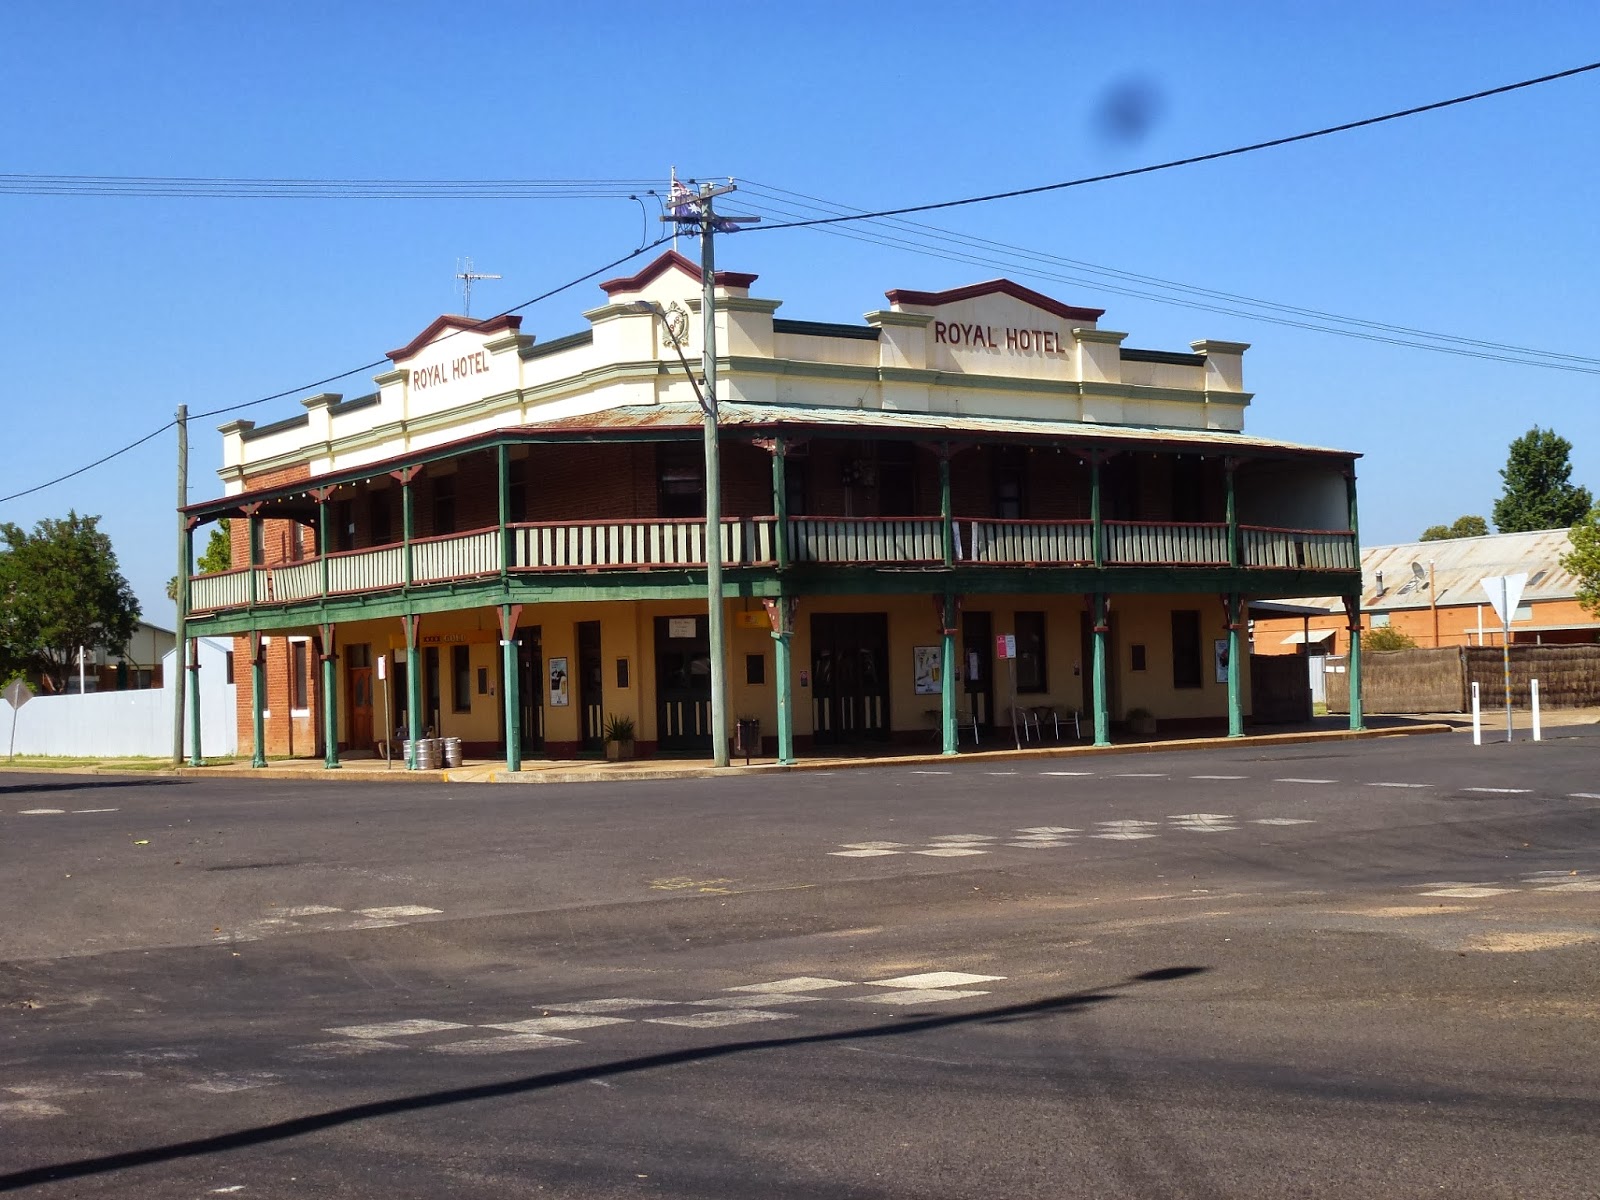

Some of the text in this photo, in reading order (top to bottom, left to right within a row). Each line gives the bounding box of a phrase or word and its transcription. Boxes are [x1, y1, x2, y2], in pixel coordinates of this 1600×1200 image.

[935, 321, 1066, 354] ROYAL HOTEL
[413, 350, 490, 392] ROYAL HOTEL
